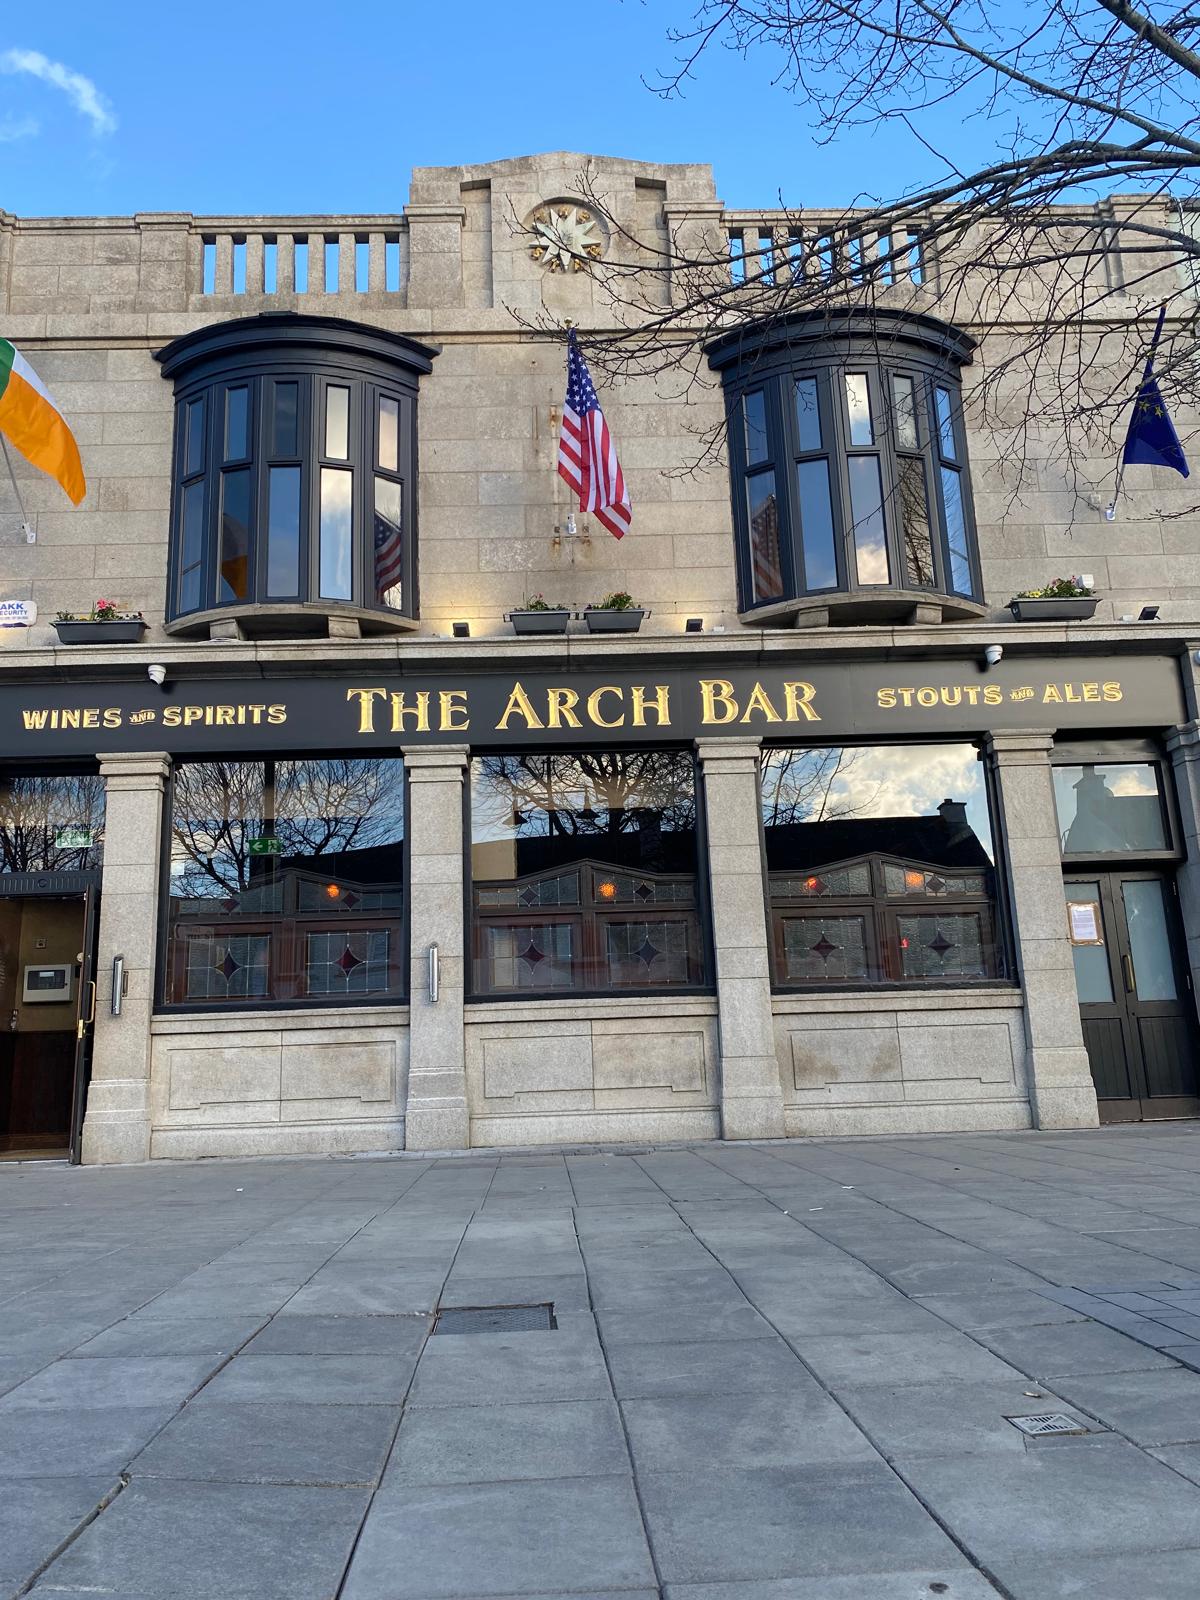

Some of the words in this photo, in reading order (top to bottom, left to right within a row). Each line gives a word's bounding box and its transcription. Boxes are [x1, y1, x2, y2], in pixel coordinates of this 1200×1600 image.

[347, 687, 470, 733] THE
[494, 681, 672, 730] ARCH
[699, 679, 822, 725] BAR
[877, 684, 1003, 708] STOUTS
[1009, 687, 1034, 701] AND
[1042, 681, 1123, 704] ALES
[22, 707, 122, 730] WINES
[129, 709, 156, 724] AND
[162, 704, 287, 727] SPIRITS
